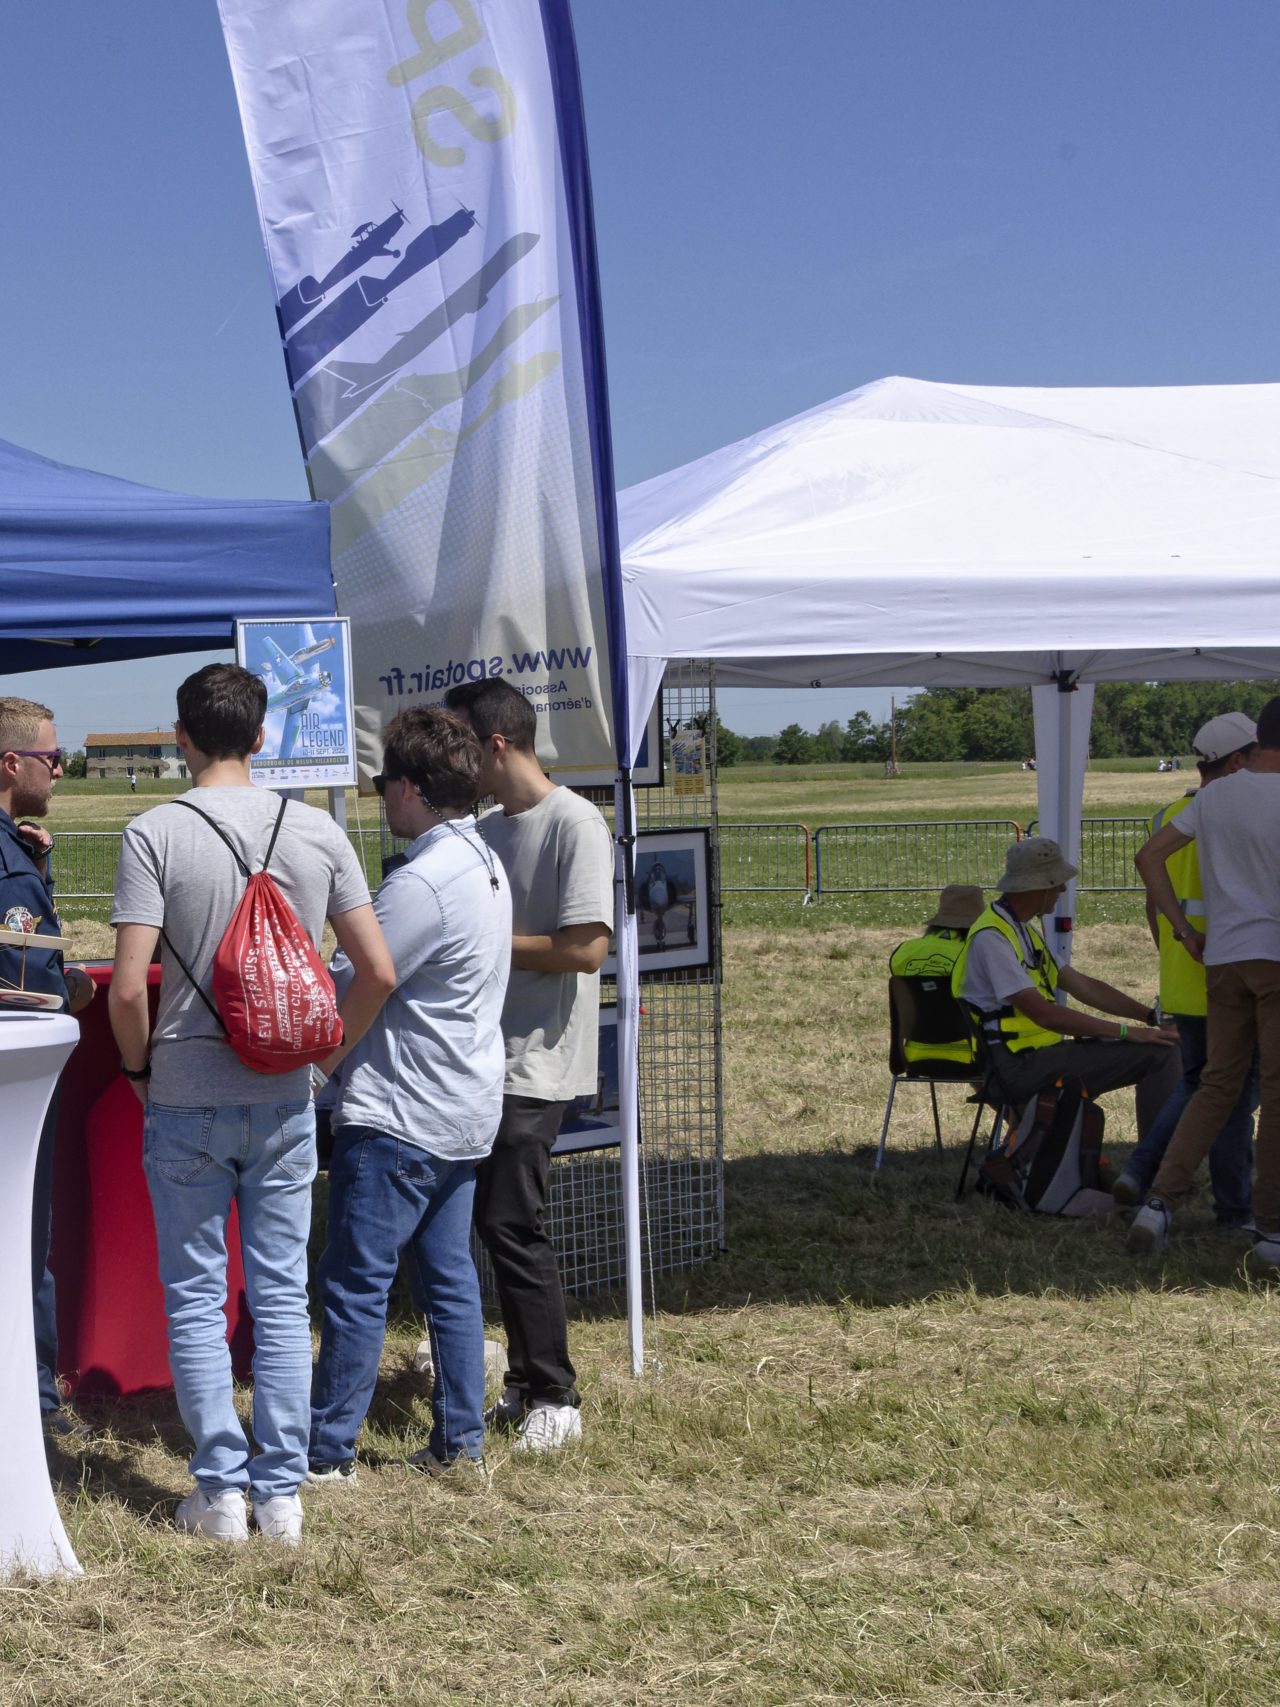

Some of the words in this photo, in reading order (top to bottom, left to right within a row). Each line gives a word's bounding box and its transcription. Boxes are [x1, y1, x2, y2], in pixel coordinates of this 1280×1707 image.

[301, 713, 320, 730] AIR
[301, 729, 345, 748] LEGEND
[244, 947, 267, 1008] STRAUSS
[280, 945, 301, 1007] CLOTHING
[275, 976, 290, 1039] ORIGINAL
[256, 1013, 272, 1046] LEVI
[292, 1008, 302, 1050] QUALITY
